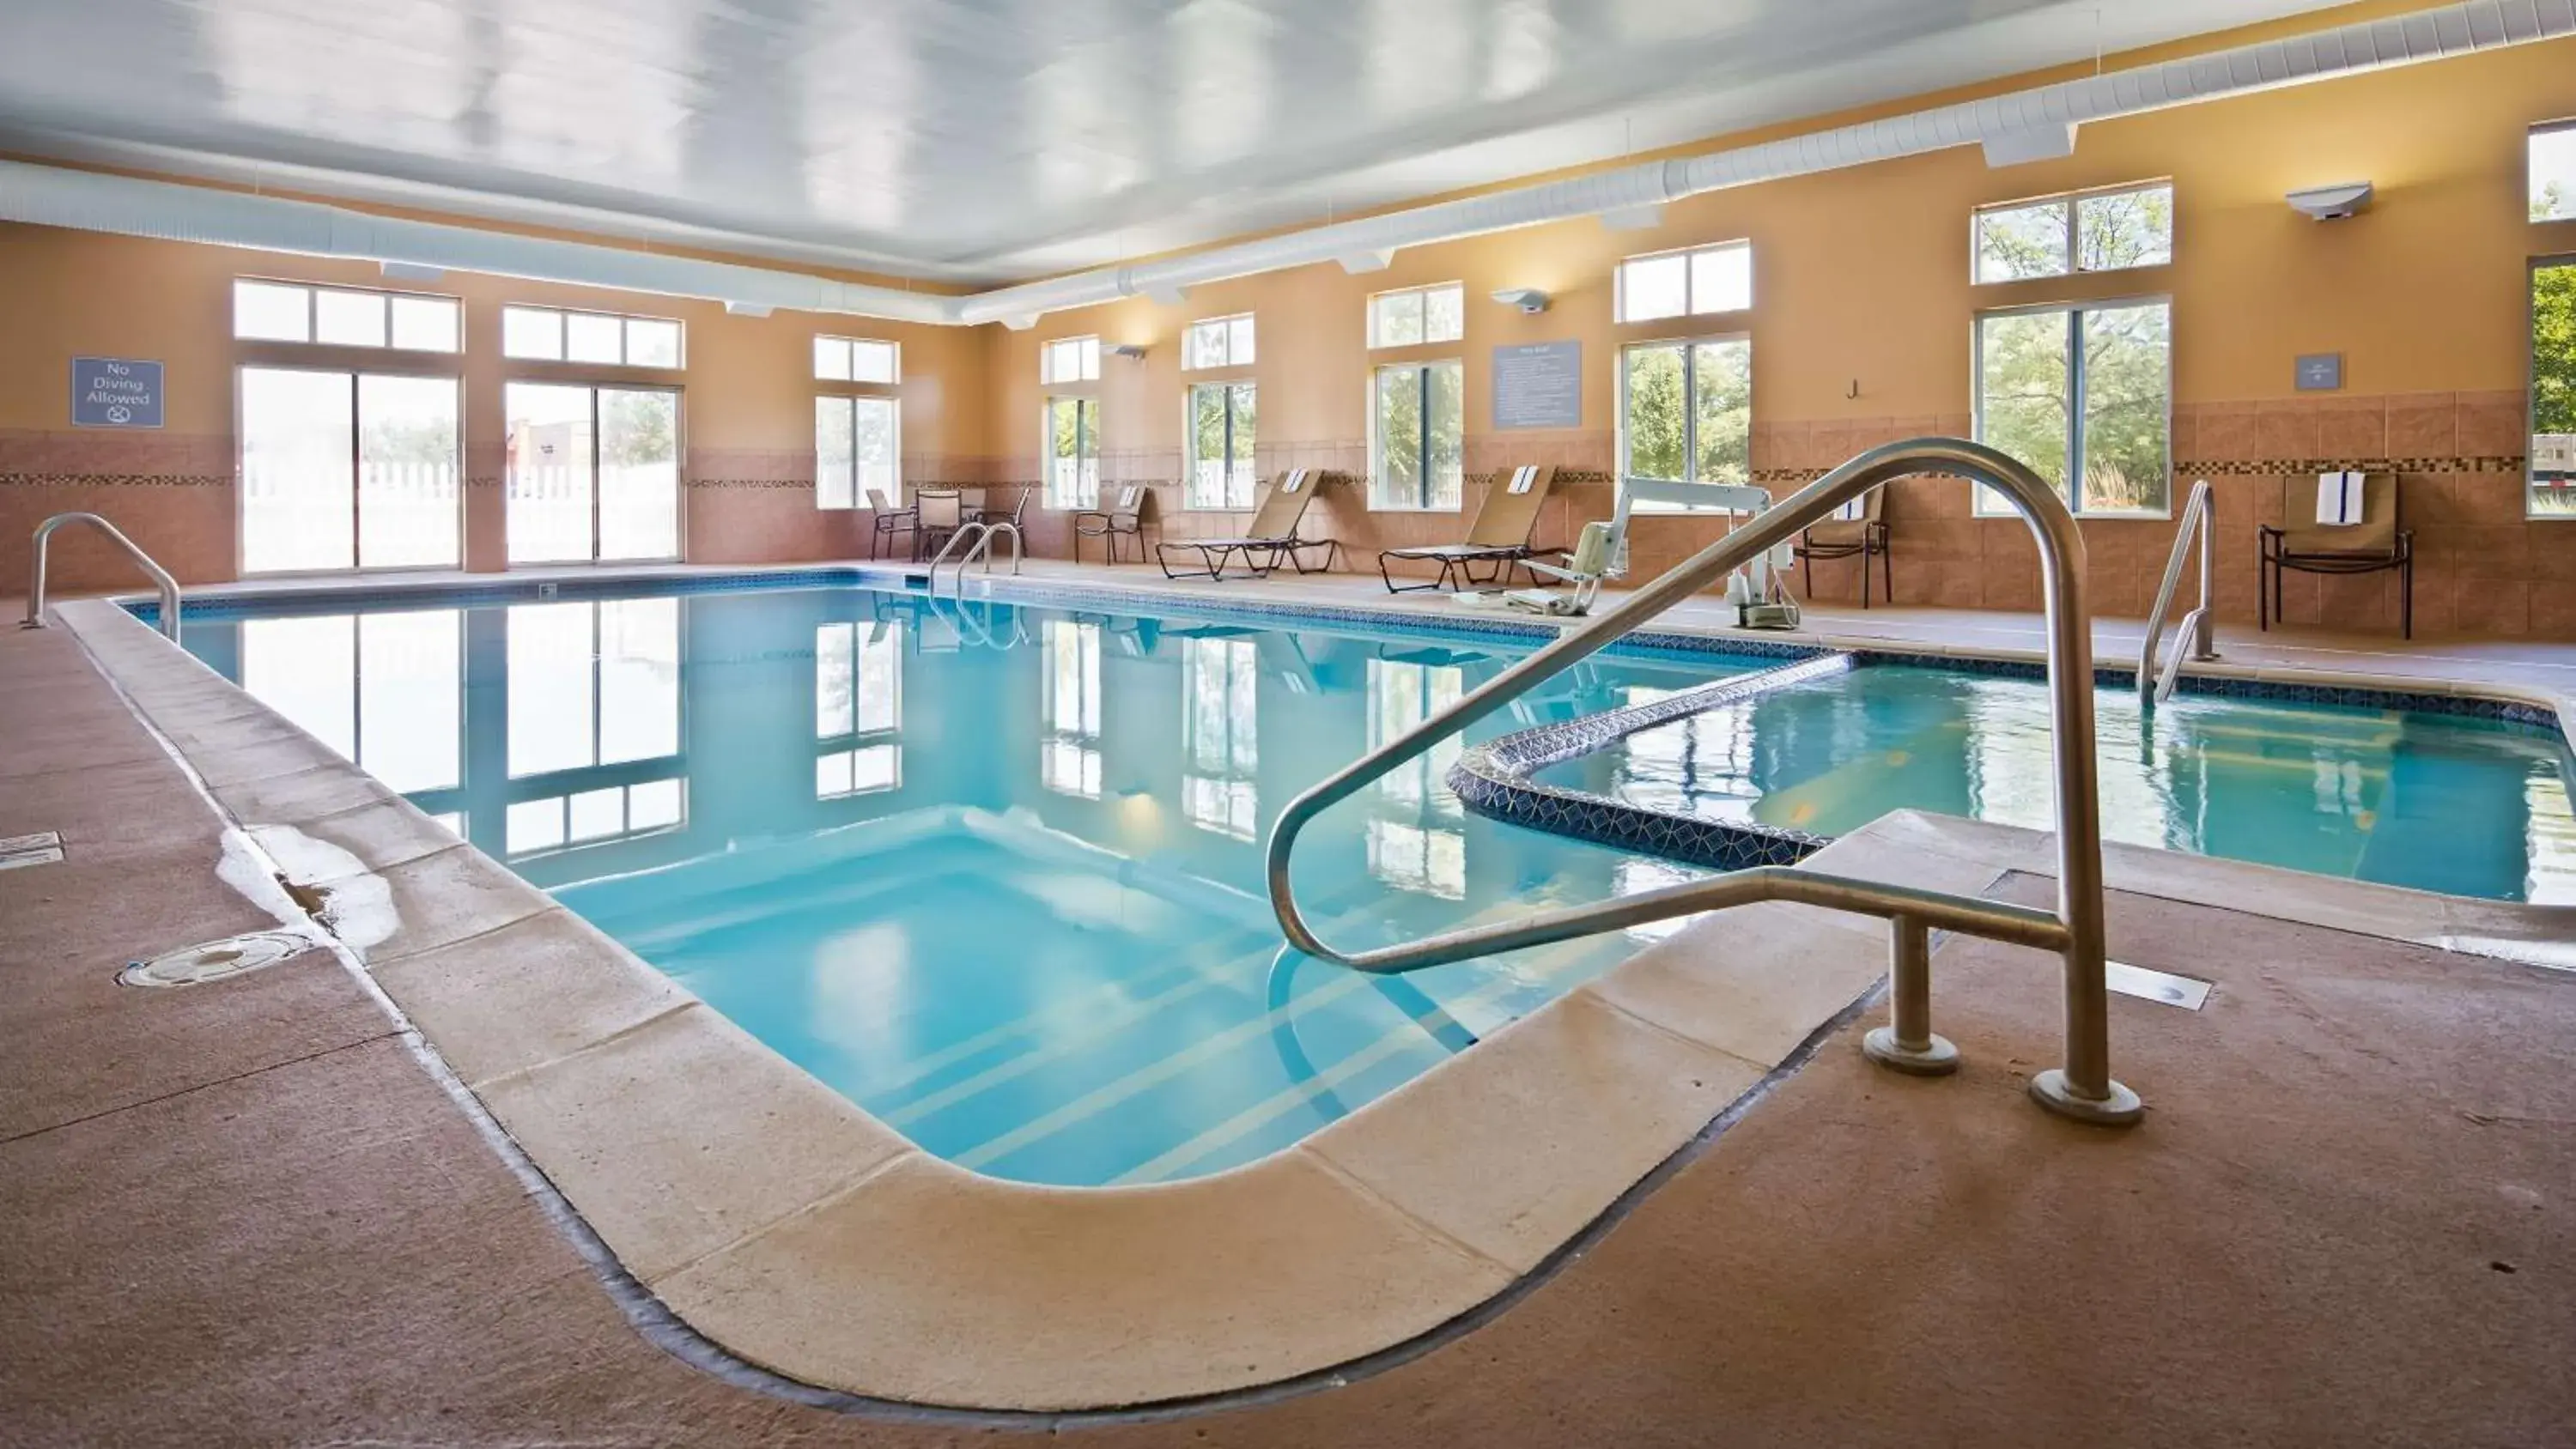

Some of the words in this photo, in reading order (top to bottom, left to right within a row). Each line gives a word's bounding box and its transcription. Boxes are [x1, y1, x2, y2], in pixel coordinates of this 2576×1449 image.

[106, 363, 130, 375] No
[94, 377, 143, 391] Diving
[87, 391, 150, 404] Allowed
